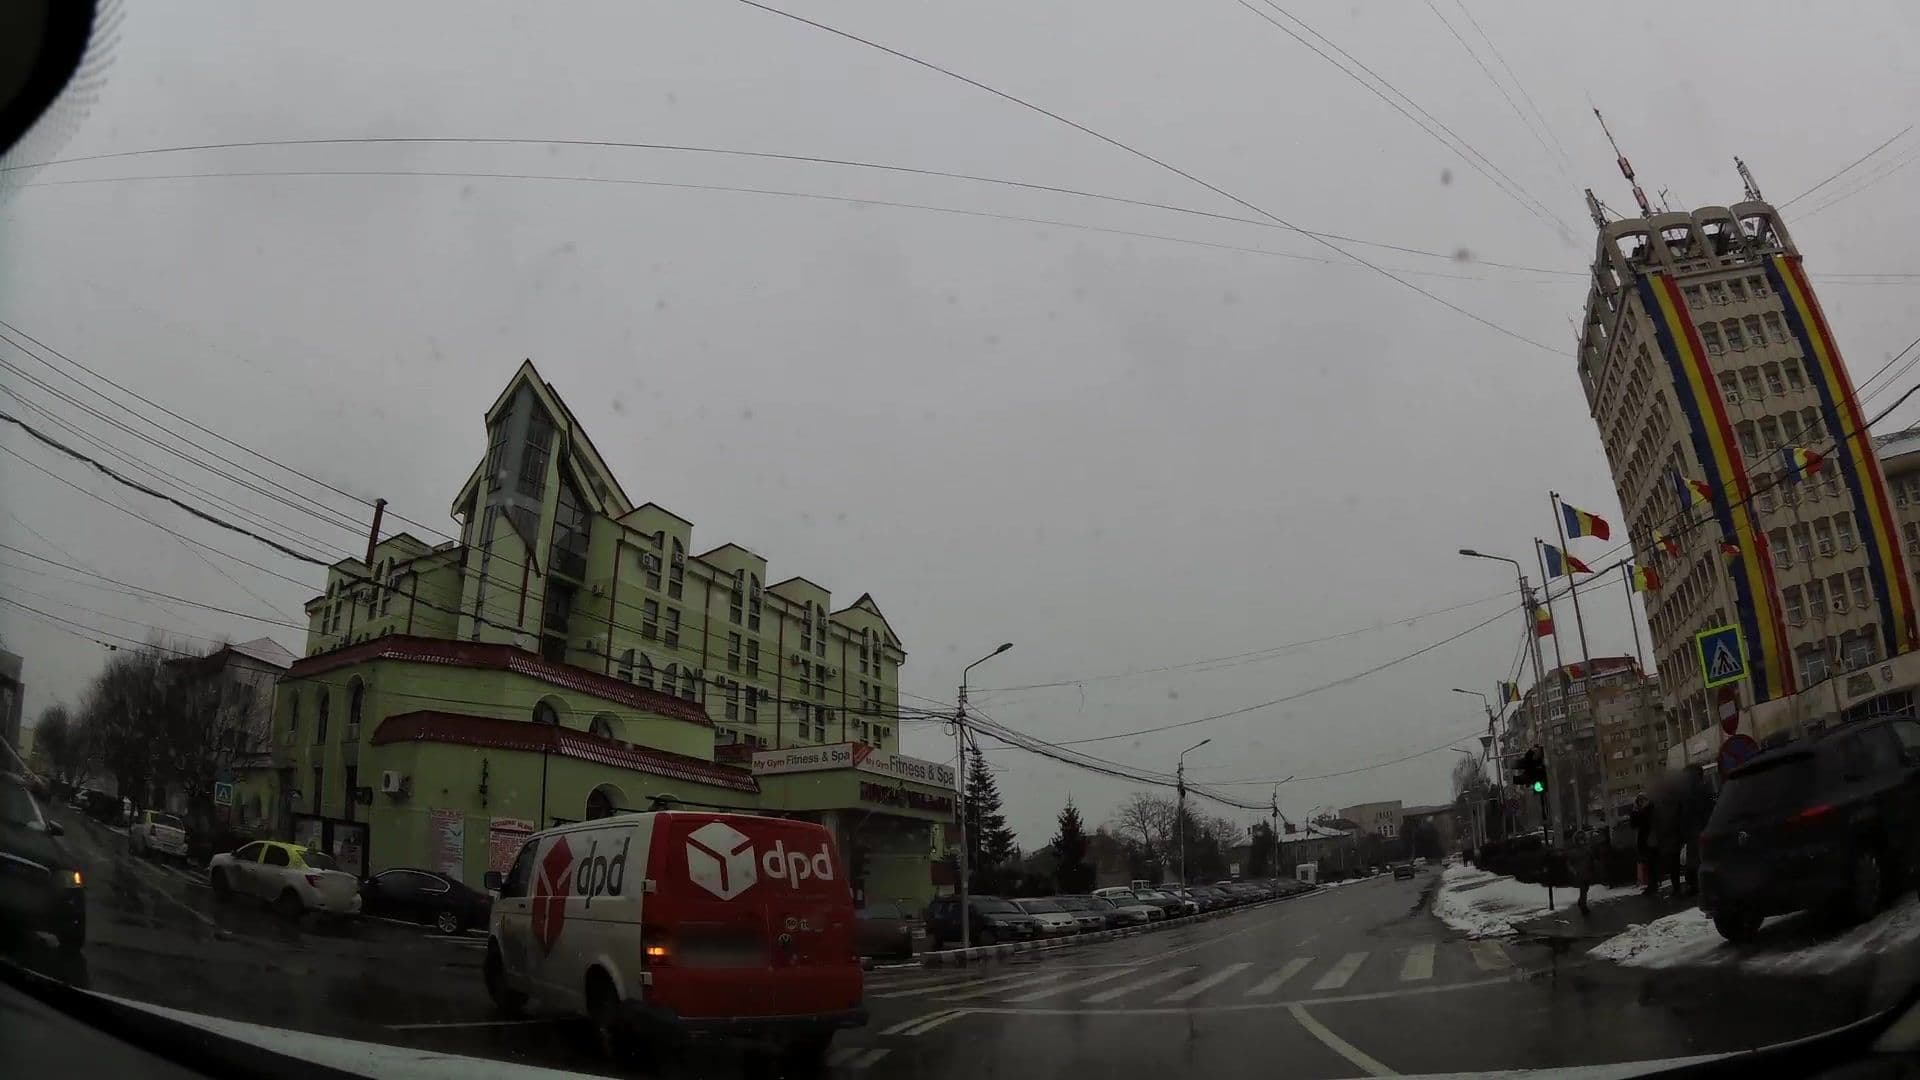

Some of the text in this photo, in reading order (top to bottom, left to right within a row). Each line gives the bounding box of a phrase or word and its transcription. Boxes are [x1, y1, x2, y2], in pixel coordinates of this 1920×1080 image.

[754, 750, 850, 769] My Gym Fitness & Spa
[889, 755, 925, 778] Fitness
[928, 767, 935, 780] &
[938, 768, 954, 785] Spa
[576, 837, 630, 909] dpd
[763, 840, 833, 889] dpd
